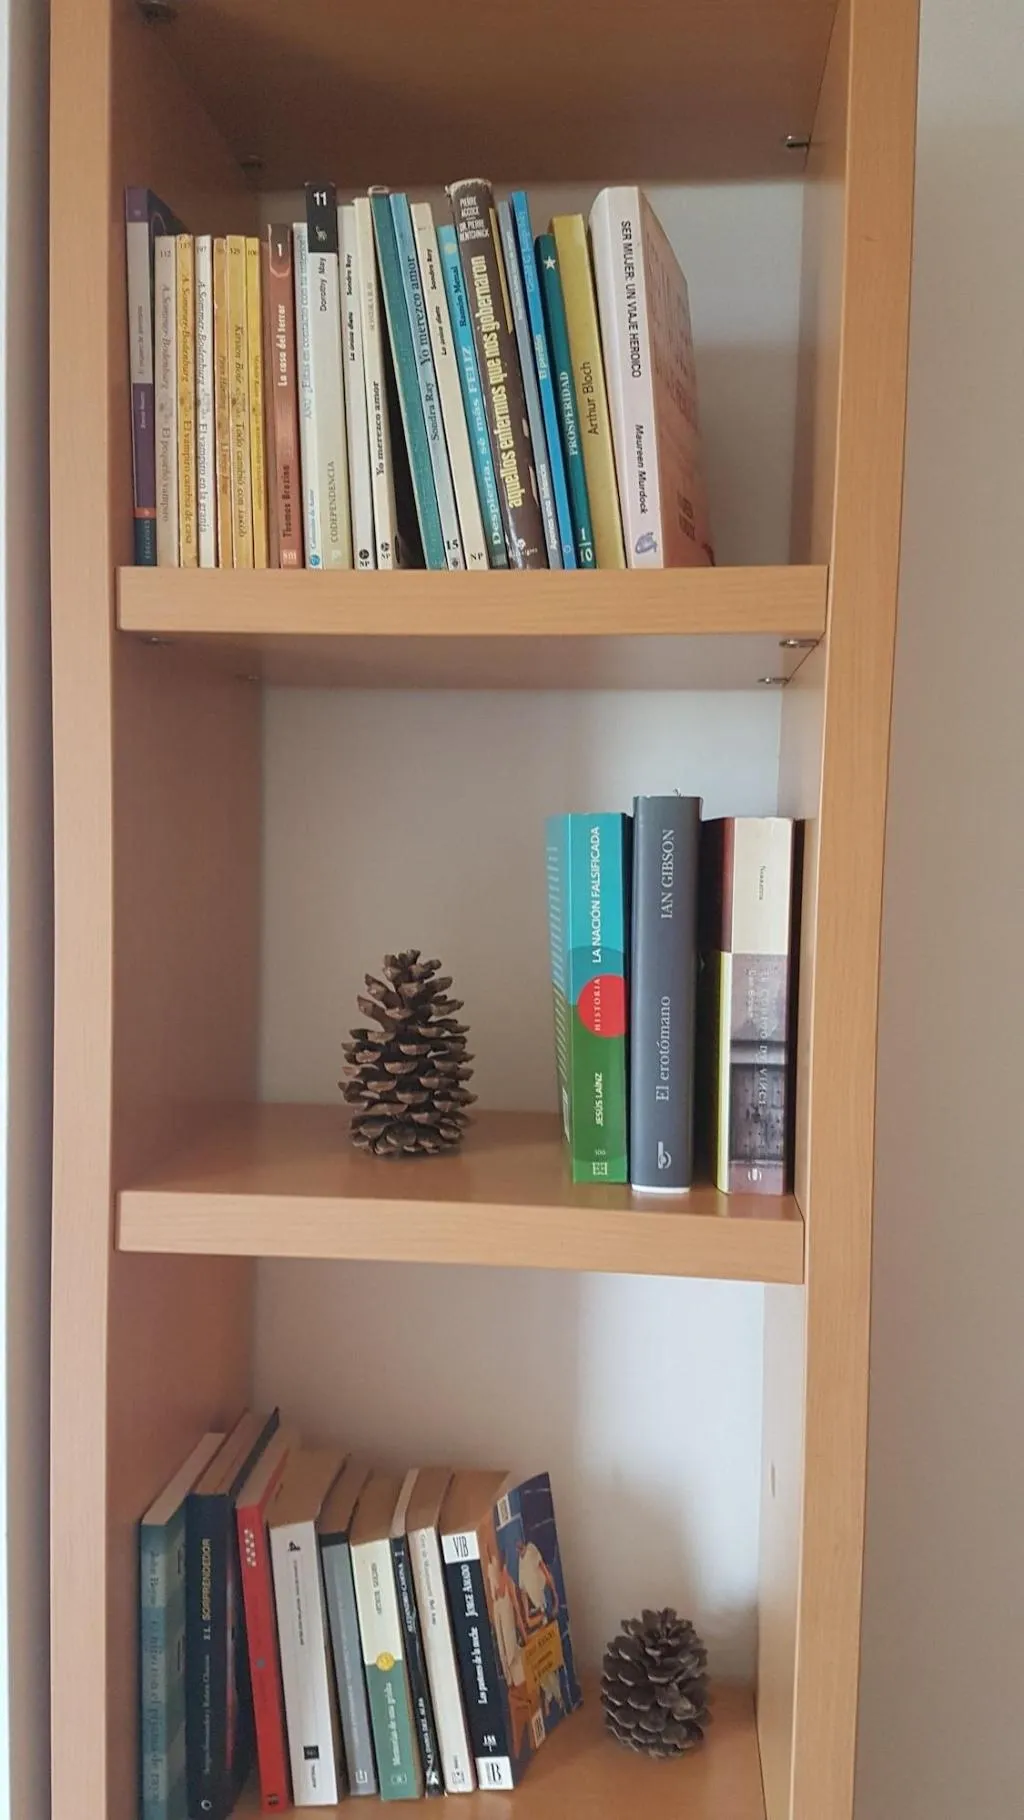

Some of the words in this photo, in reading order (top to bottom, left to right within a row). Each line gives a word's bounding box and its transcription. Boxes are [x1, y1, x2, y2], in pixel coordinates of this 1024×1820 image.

[313, 191, 327, 206] 11
[621, 220, 632, 241] SER
[317, 257, 327, 275] May
[405, 255, 419, 290] amor
[622, 242, 635, 282] MUJER:
[318, 279, 328, 312] Dorothy
[470, 255, 500, 332] gobernaron
[625, 283, 637, 299] UN
[276, 303, 286, 332] terror
[412, 292, 429, 346] merezco
[455, 295, 467, 328] Ramón
[627, 301, 639, 331] VIAJE
[277, 334, 287, 350] del
[420, 348, 432, 366] Yo
[482, 332, 500, 357] nos
[629, 332, 642, 378] HEROICO
[278, 351, 288, 373] casa
[463, 346, 477, 394] FELIZ
[485, 358, 508, 385] que
[580, 361, 594, 394] Bloch
[277, 375, 288, 387] La
[371, 380, 381, 411] amor
[424, 381, 435, 402] Ray
[183, 420, 192, 431] El
[198, 423, 208, 434] El
[428, 404, 440, 441] Sondra
[471, 398, 484, 432] más
[490, 385, 514, 450] enfermos
[559, 371, 579, 456] PROSPERIDAD
[585, 397, 599, 436] Arthur
[374, 413, 384, 460] merezco
[634, 424, 645, 469] Maureen
[182, 432, 192, 473] vampiro
[197, 435, 208, 476] vampiro
[199, 477, 206, 490] en
[375, 462, 385, 476] Yo
[500, 450, 525, 509] aquellos
[184, 474, 193, 509] cambia
[199, 491, 208, 501] la
[326, 460, 339, 544] CODEPENDENCIA
[637, 470, 649, 514] Murdock
[184, 510, 193, 522] de
[282, 503, 292, 538] Thomas
[590, 826, 601, 898] FALSIFICADA
[660, 828, 675, 889] GIBSON
[660, 891, 673, 919] IAN
[589, 900, 601, 947] NACIÓN
[591, 948, 602, 963] LA
[593, 978, 601, 1032] HISTORIA
[656, 996, 671, 1082] erotómano
[655, 1085, 669, 1101] El
[594, 1100, 604, 1127] JESÚS
[452, 1536, 469, 1558] VIB
[201, 1538, 212, 1621] SORPRENDEDOR
[460, 1564, 473, 1593] AMADO
[463, 1593, 478, 1618] JORGE
[468, 1627, 479, 1648] noche
[470, 1648, 480, 1656] la
[471, 1655, 482, 1665] de
